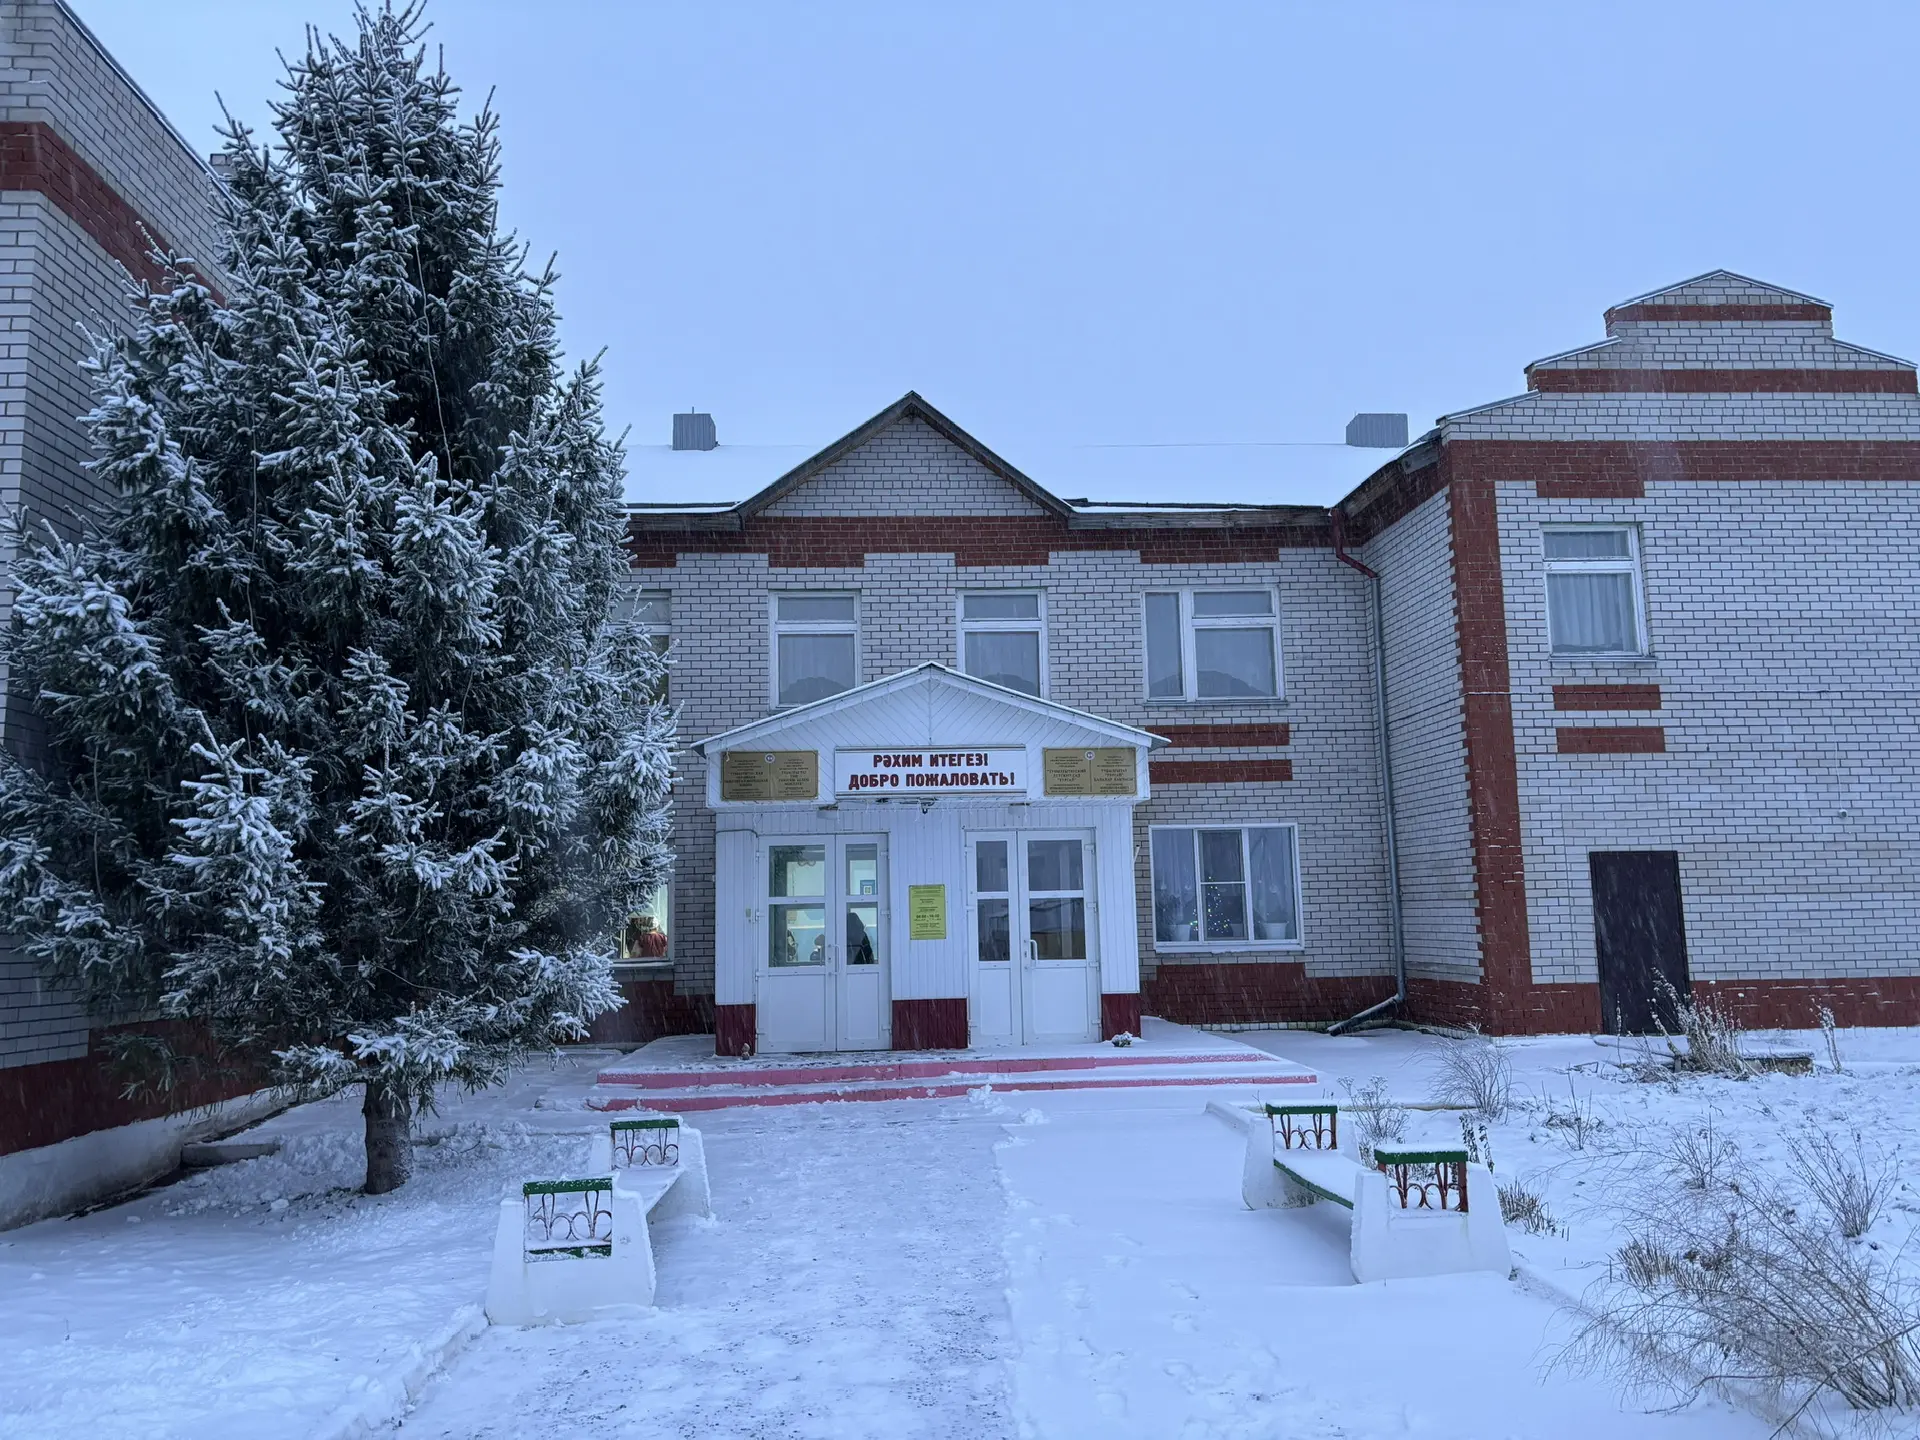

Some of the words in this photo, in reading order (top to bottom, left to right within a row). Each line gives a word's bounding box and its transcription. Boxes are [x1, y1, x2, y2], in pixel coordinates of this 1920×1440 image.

[873, 754, 923, 768] РӘХИМ
[929, 753, 989, 767] ИТЕГЕЗ!
[848, 773, 900, 790] ДОБРО
[905, 772, 1015, 787] ПОЖАЛОВАТЬ!
